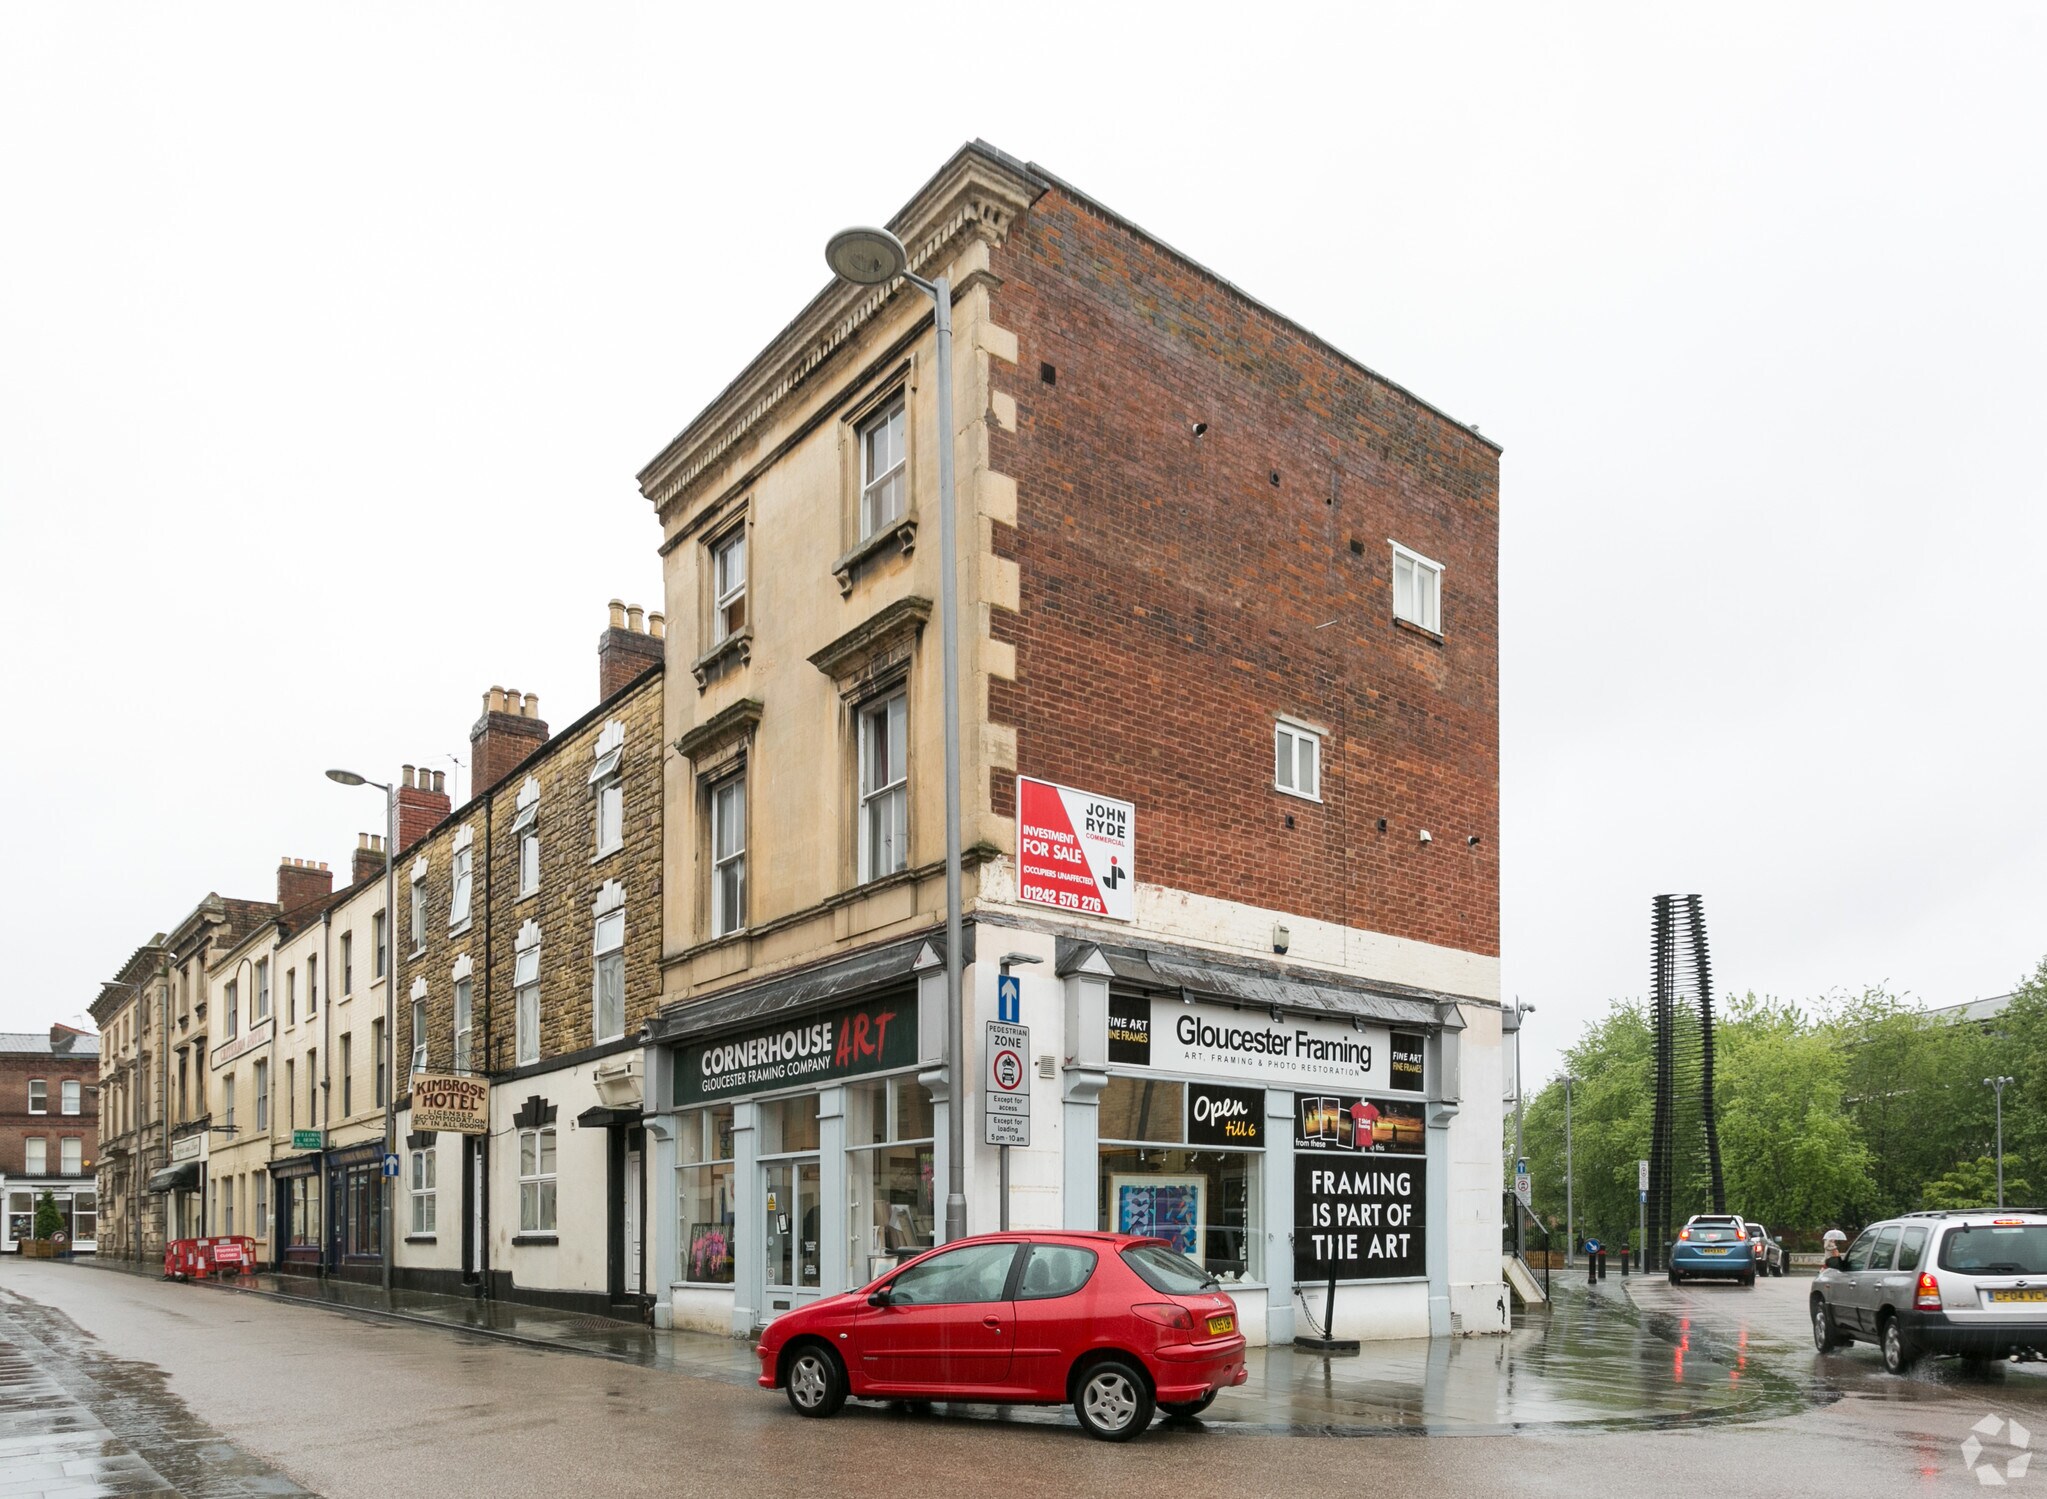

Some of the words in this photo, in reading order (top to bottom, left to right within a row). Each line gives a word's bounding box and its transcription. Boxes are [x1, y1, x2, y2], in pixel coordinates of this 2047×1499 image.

[1086, 803, 1126, 824] JOHN
[1023, 825, 1075, 845] INVESTMENT
[1086, 817, 1126, 839] RYDE
[1085, 832, 1125, 847] COMMERCIAL
[1023, 838, 1049, 858] FOR
[1053, 844, 1082, 864] SALE
[1023, 864, 1057, 878] (OCCUPIERS
[1057, 871, 1094, 887] UNAFFECTED)
[1023, 884, 1057, 904] 01242
[1059, 891, 1079, 908] 576
[1081, 895, 1102, 912] 276
[989, 1024, 1027, 1037] PEDESTRIAN
[1108, 1016, 1128, 1028] INE
[1129, 1018, 1149, 1031] ART
[835, 1012, 897, 1067] ART
[994, 1035, 1022, 1049] ZONE
[1108, 1029, 1120, 1040] INE
[1121, 1030, 1148, 1044] FRAMES
[1176, 1014, 1292, 1057] Gloucester
[1295, 1030, 1372, 1072] Framing
[701, 1022, 832, 1077] CORNERHOUSE
[1392, 1051, 1408, 1061] FINE
[1409, 1053, 1422, 1063] ART
[1184, 1051, 1207, 1062] ART,
[1211, 1053, 1253, 1066] FRAMING
[1257, 1059, 1263, 1067] &
[1267, 1060, 1297, 1071] PHOTO
[1301, 1063, 1360, 1077] RESTORATION
[1392, 1061, 1404, 1072] FINE
[1403, 1062, 1423, 1074] FRAMES
[702, 1071, 747, 1092] GLOUCESTER
[748, 1062, 785, 1084] FRAMING
[787, 1055, 831, 1077] COMPANY
[416, 1079, 486, 1101] KIMBROSE
[422, 1092, 479, 1111] HOTEL
[993, 1095, 1013, 1104] Except
[998, 1104, 1018, 1112] access
[415, 1113, 486, 1124] ACCOMMODATION
[428, 1109, 474, 1118] LICENSED
[1193, 1095, 1248, 1127] Open
[459, 1122, 485, 1130] ROOMS
[993, 1116, 1013, 1125] Except
[1014, 1118, 1023, 1126] for
[997, 1125, 1019, 1134] loading
[1225, 1120, 1248, 1137] till
[1248, 1123, 1256, 1137] 6
[1295, 1138, 1310, 1147] from
[1310, 1140, 1327, 1148] these
[1375, 1143, 1385, 1152] this
[1311, 1170, 1411, 1196] FRAMING
[1312, 1202, 1332, 1227] IS
[1336, 1203, 1382, 1227] PART
[1386, 1203, 1412, 1227] OF
[1367, 1233, 1411, 1259] ART
[1995, 1291, 2025, 1301] CF04
